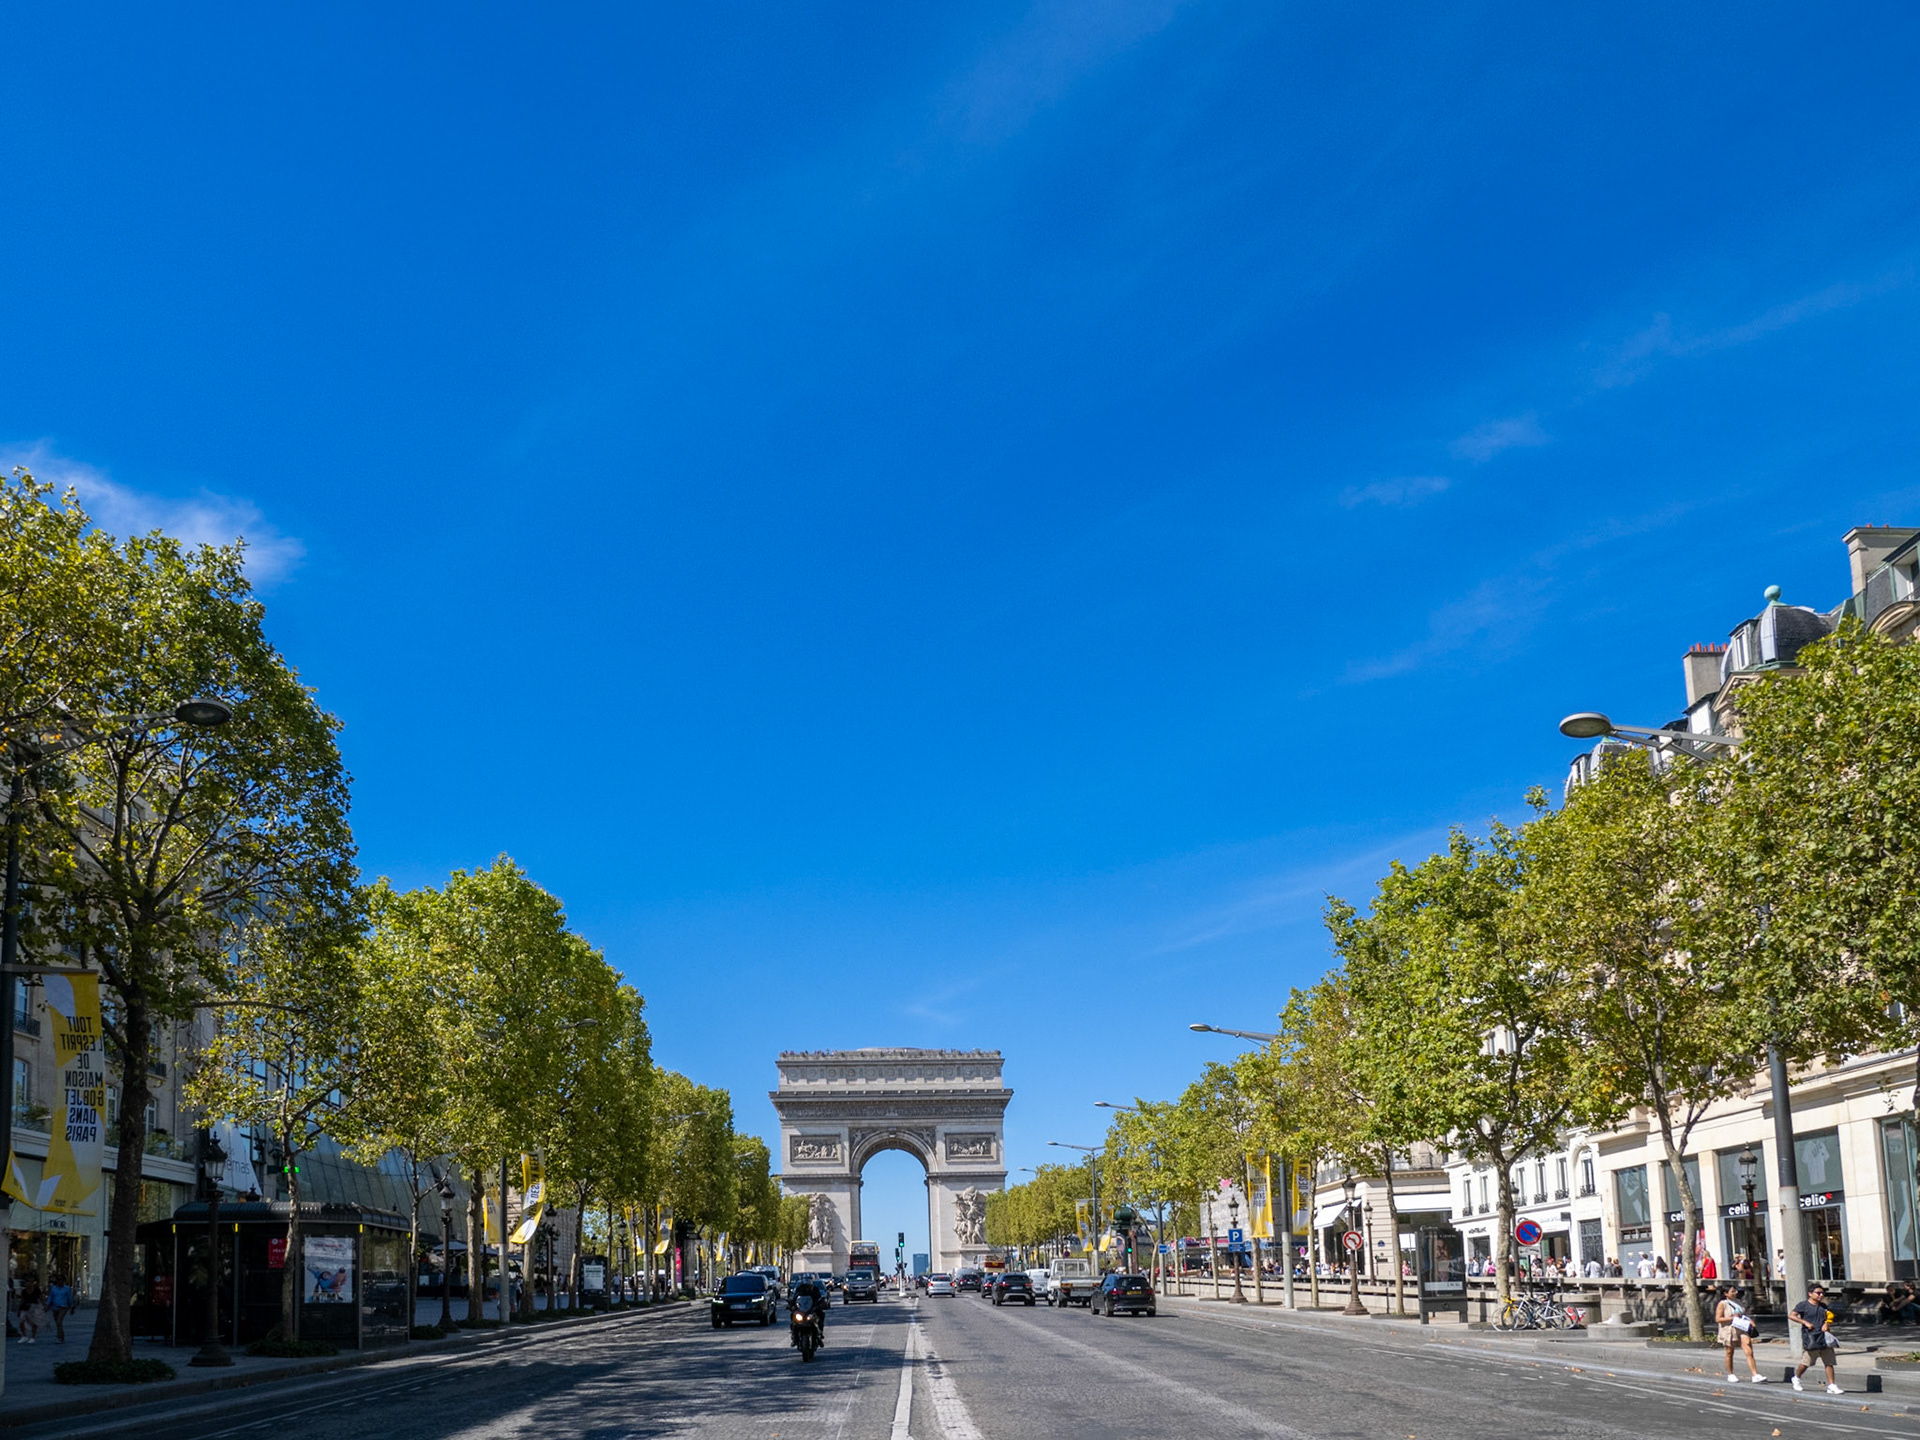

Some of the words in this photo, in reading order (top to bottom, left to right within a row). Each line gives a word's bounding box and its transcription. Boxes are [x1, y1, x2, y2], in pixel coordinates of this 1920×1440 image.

[1800, 1194, 1826, 1207] celio
[1670, 1211, 1686, 1222] celi
[1233, 1231, 1239, 1241] P
